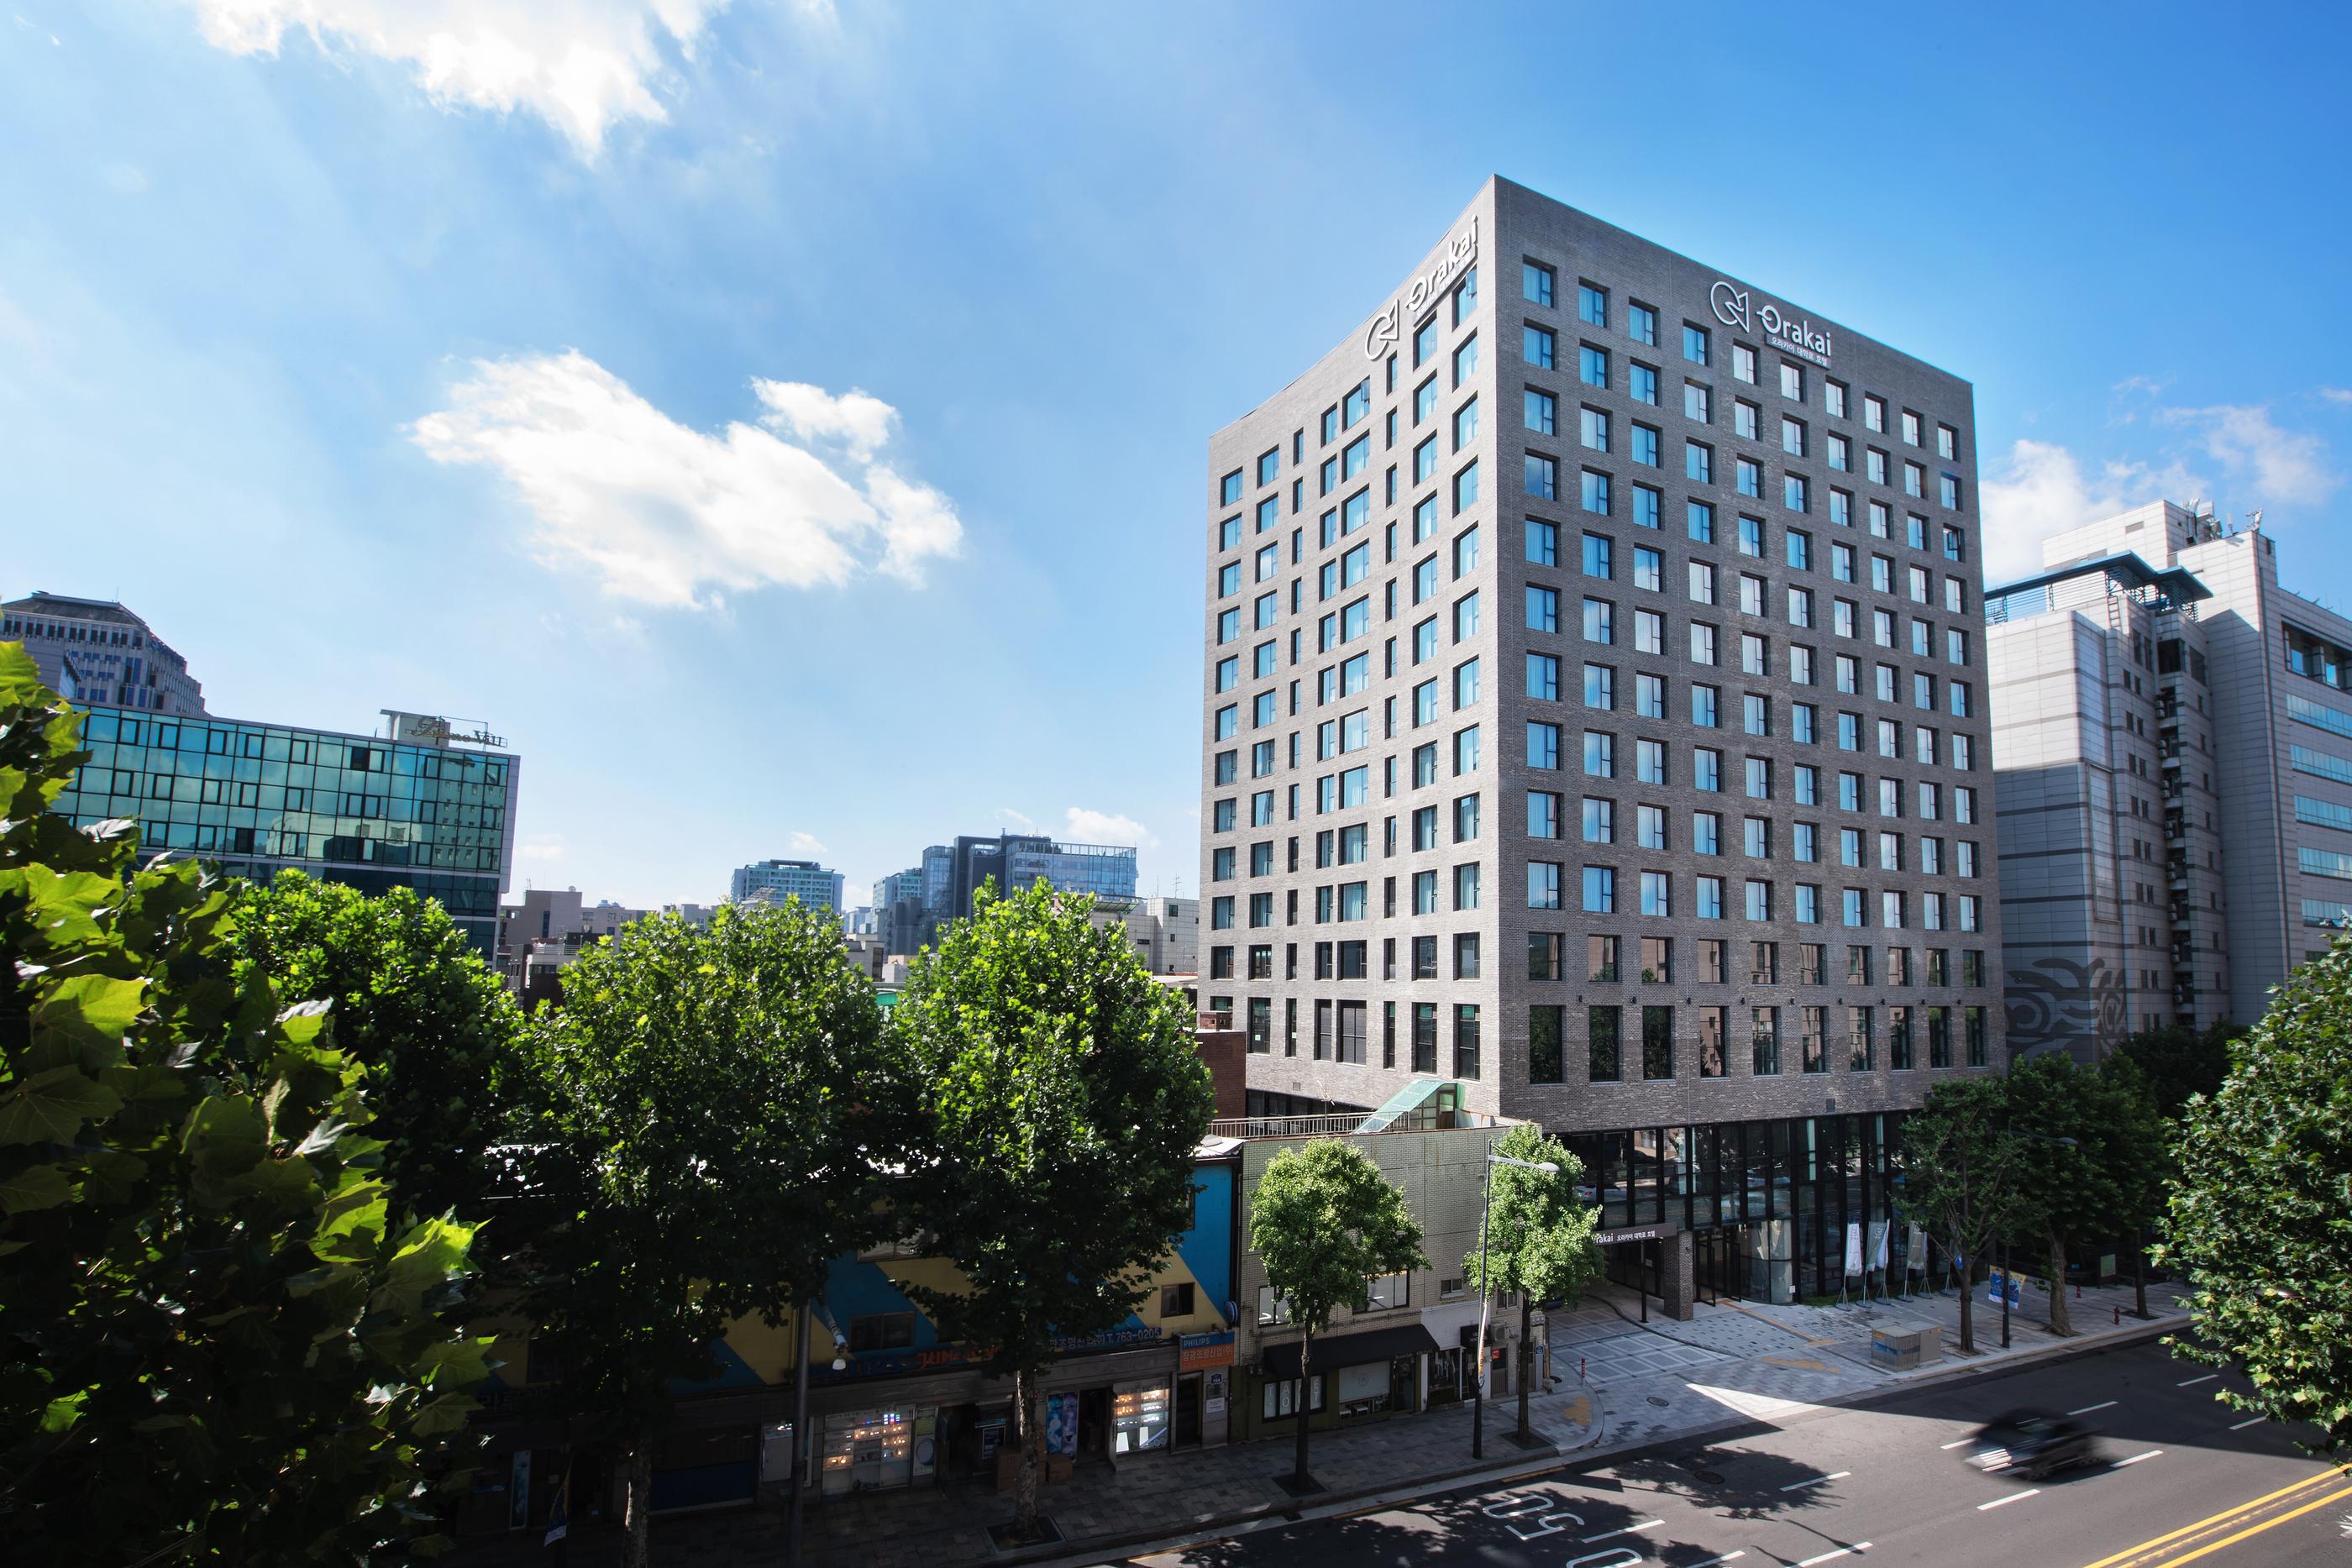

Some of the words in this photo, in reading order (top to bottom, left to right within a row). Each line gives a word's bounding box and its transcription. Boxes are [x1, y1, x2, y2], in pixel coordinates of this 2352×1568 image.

[1404, 214, 1478, 312] Orakai
[1756, 305, 1831, 357] Orakai
[1772, 337, 1795, 354] 오라카이
[1594, 1232, 1614, 1244] rakai
[1617, 1233, 1634, 1241] 오라카이
[1116, 1327, 1160, 1342] 763-0205
[1184, 1337, 1210, 1347] PHILIPS
